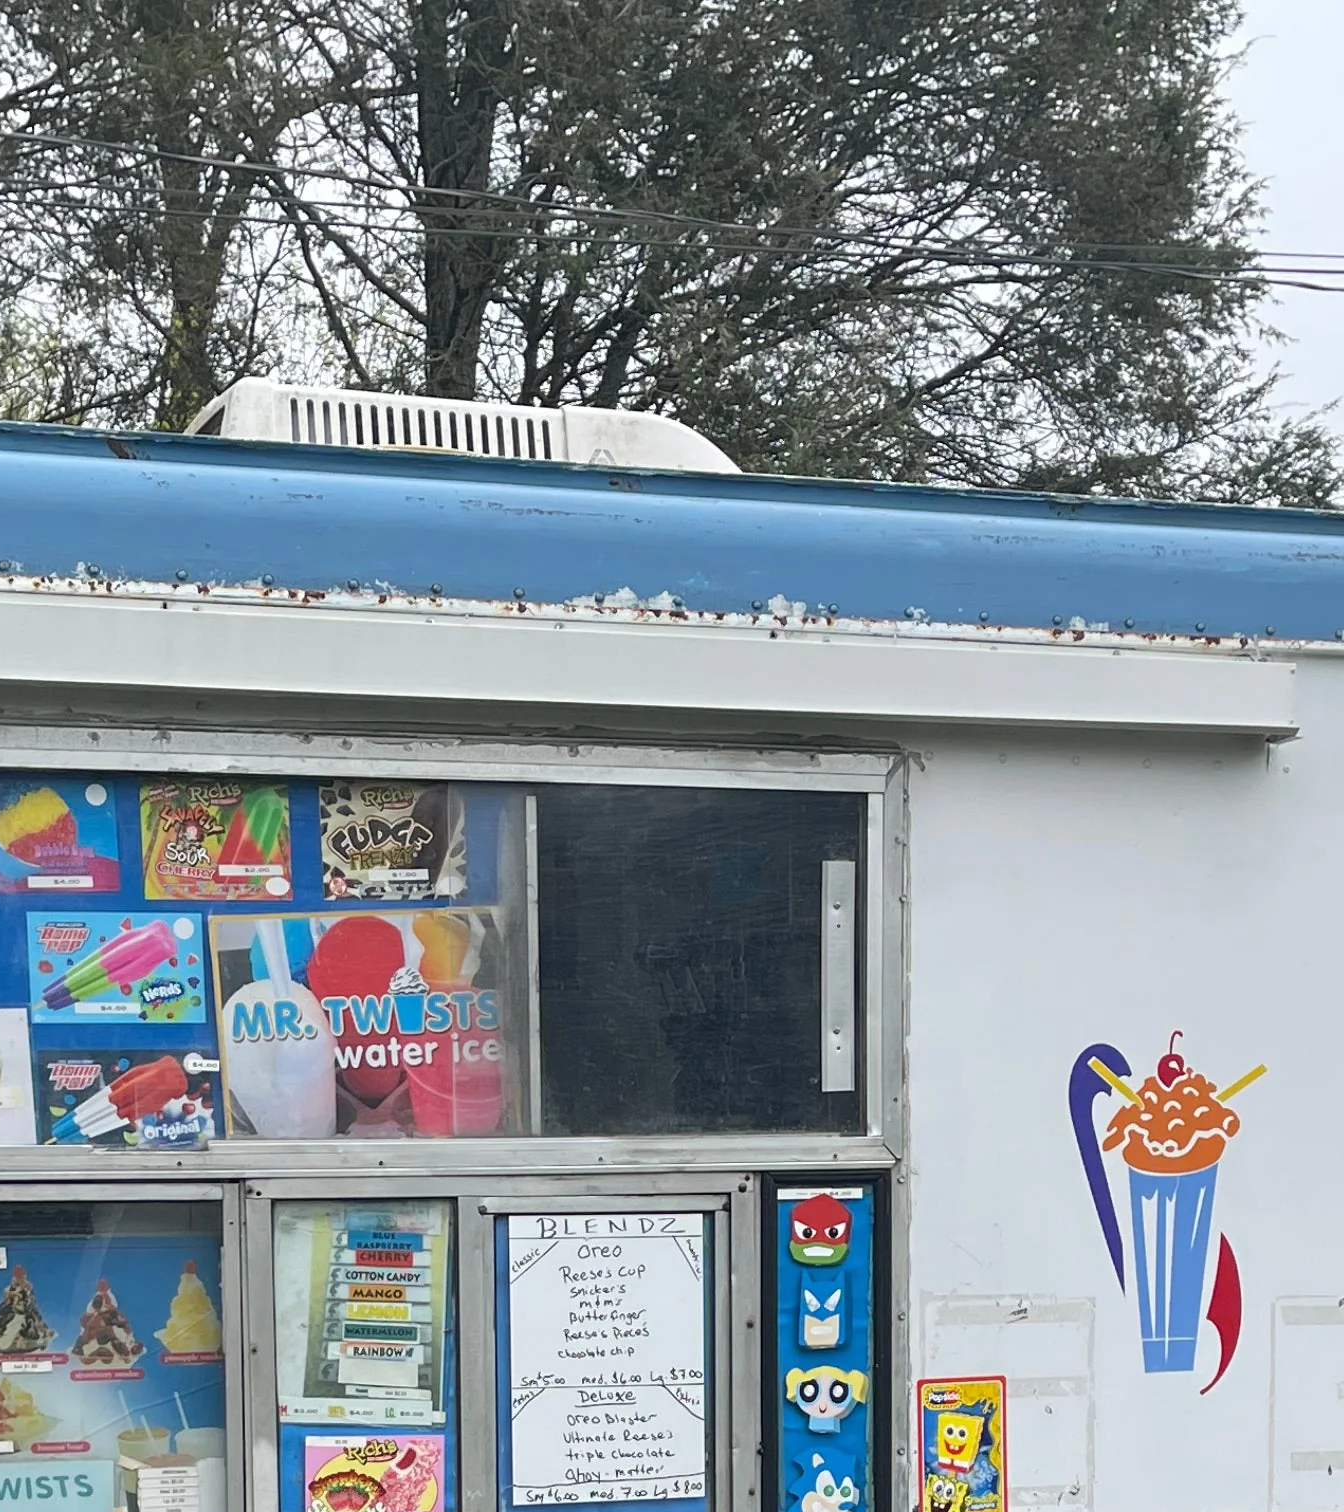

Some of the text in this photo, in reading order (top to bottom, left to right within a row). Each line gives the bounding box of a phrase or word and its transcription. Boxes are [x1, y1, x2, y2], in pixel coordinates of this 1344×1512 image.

[329, 816, 433, 861] FUDGE
[164, 842, 210, 866] SOUR
[349, 847, 416, 870] FRENZY
[156, 861, 217, 880] CHERRY
[232, 999, 318, 1042] MR.
[333, 1031, 504, 1070] water ice
[143, 1120, 201, 1141] Original
[372, 1231, 396, 1240] BLUE
[536, 1217, 686, 1239] BLENDZ
[359, 1251, 410, 1262] CHERRY
[577, 1244, 622, 1259] Oreo
[345, 1270, 421, 1283] COTTON CANDY
[352, 1288, 403, 1299] MANGO
[345, 1327, 413, 1337] WATERMELON
[353, 1346, 404, 1357] RAINBOW
